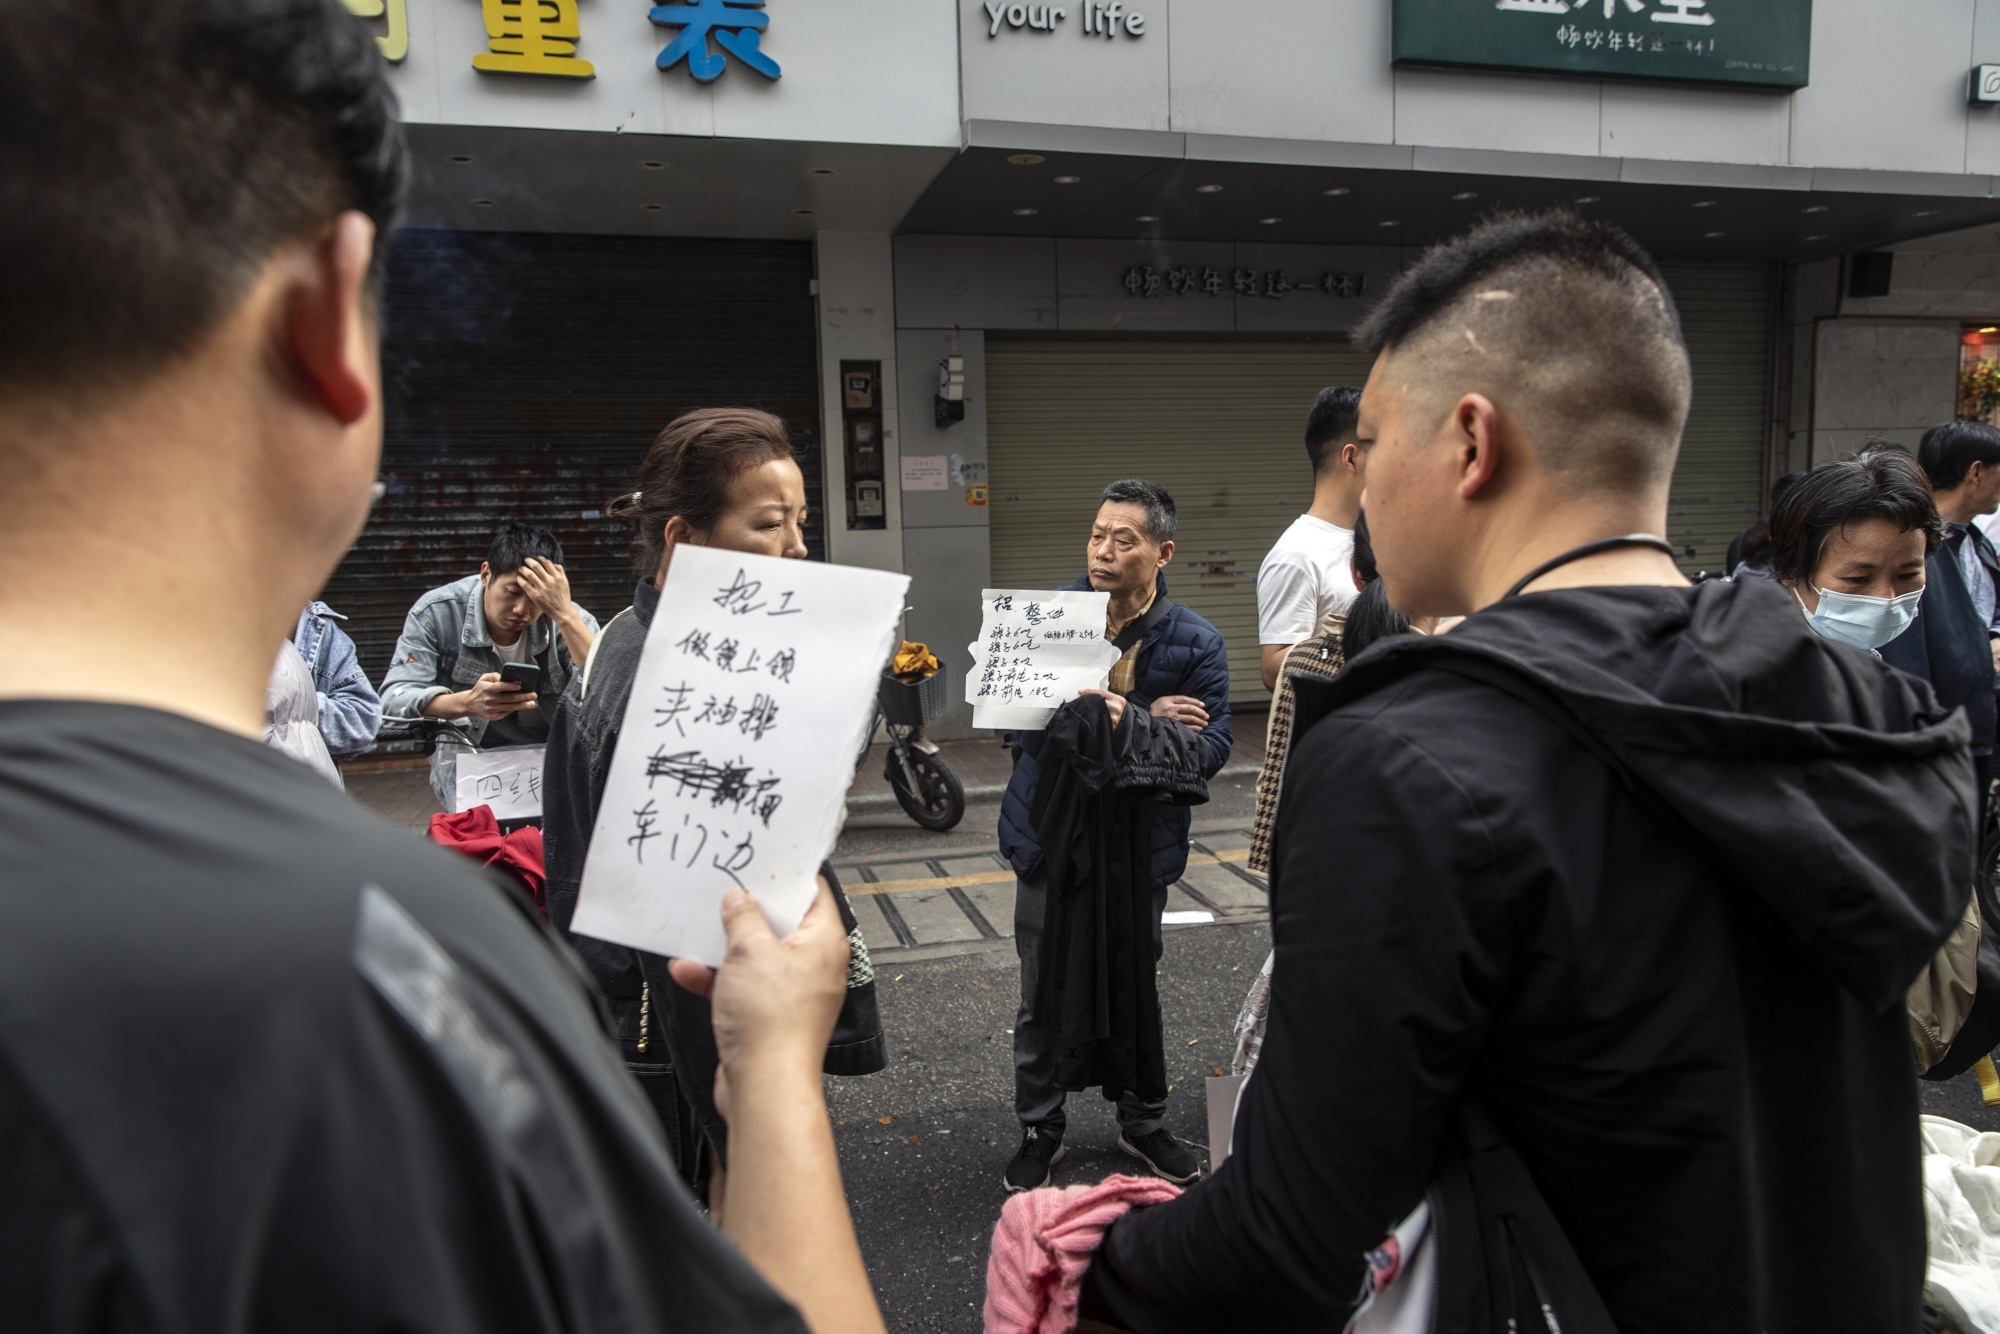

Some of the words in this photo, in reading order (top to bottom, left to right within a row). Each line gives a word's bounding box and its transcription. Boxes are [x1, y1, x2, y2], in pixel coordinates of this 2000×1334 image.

[984, 0, 1067, 38] your
[1082, 0, 1146, 38] life
[713, 568, 803, 616] 招工
